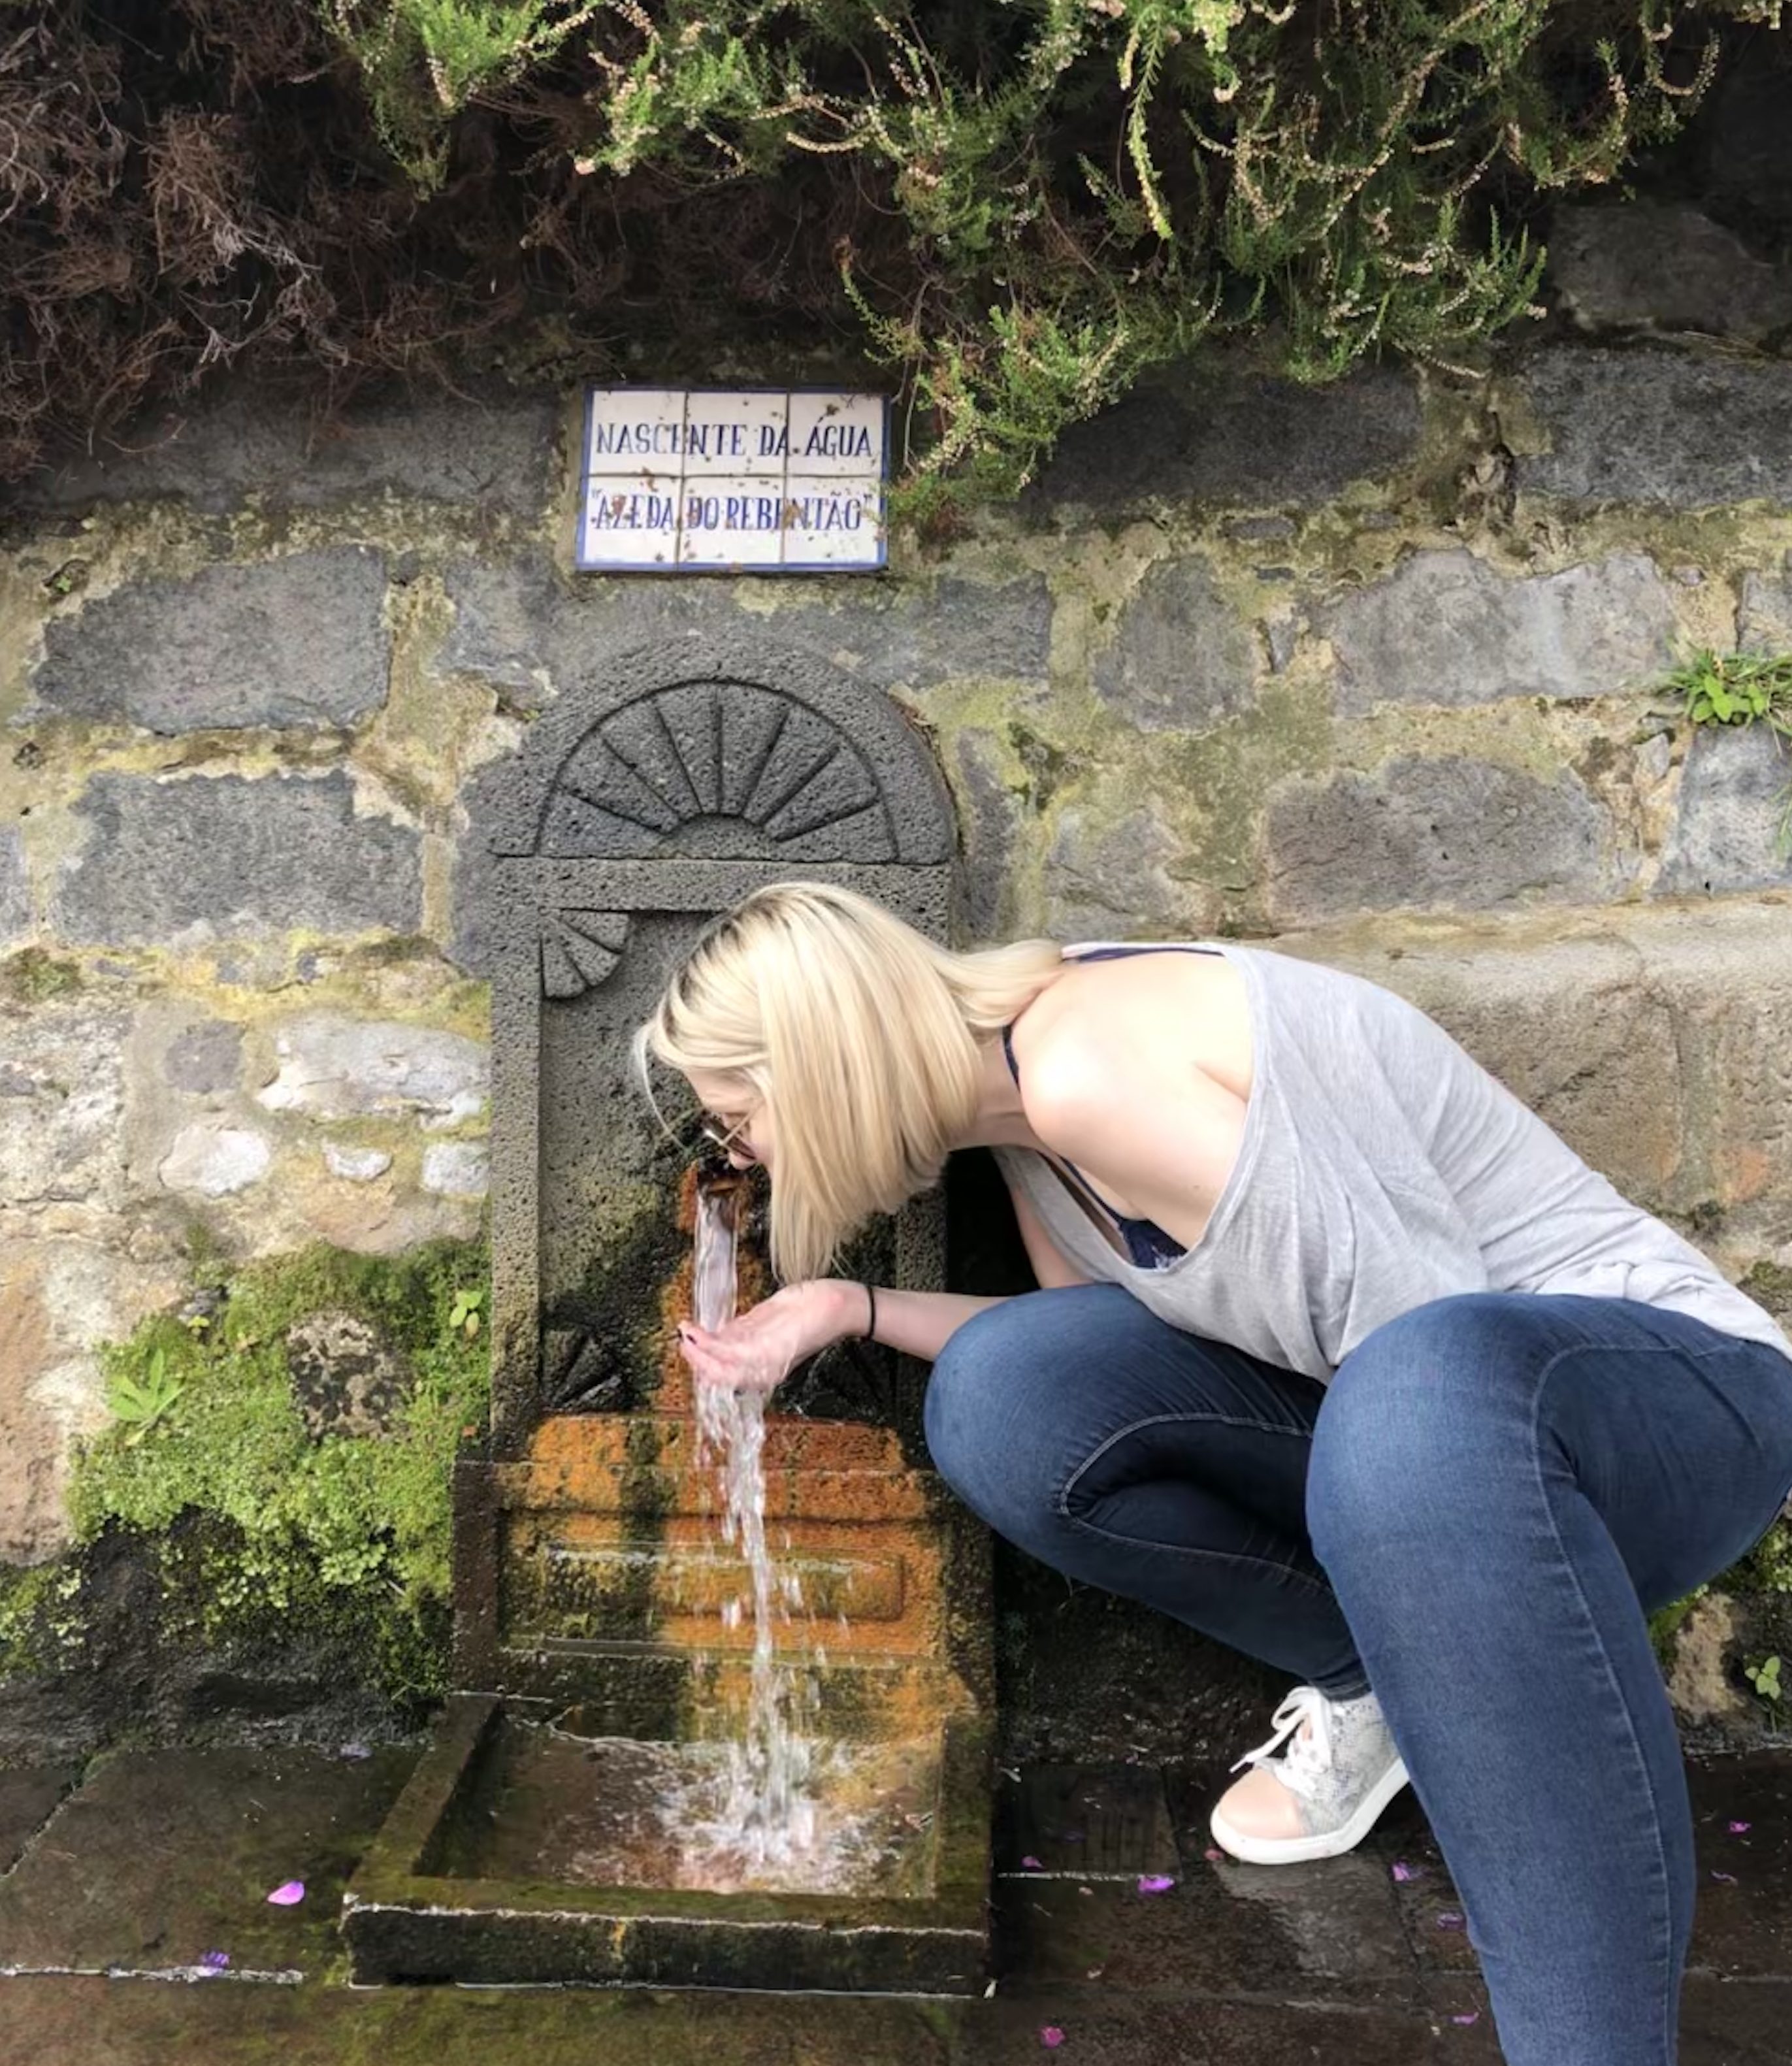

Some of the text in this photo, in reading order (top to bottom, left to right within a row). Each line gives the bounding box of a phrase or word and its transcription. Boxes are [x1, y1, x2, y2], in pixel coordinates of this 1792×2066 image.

[595, 416, 872, 458] NASCENTE DA ÁGUA
[685, 497, 719, 530] DO
